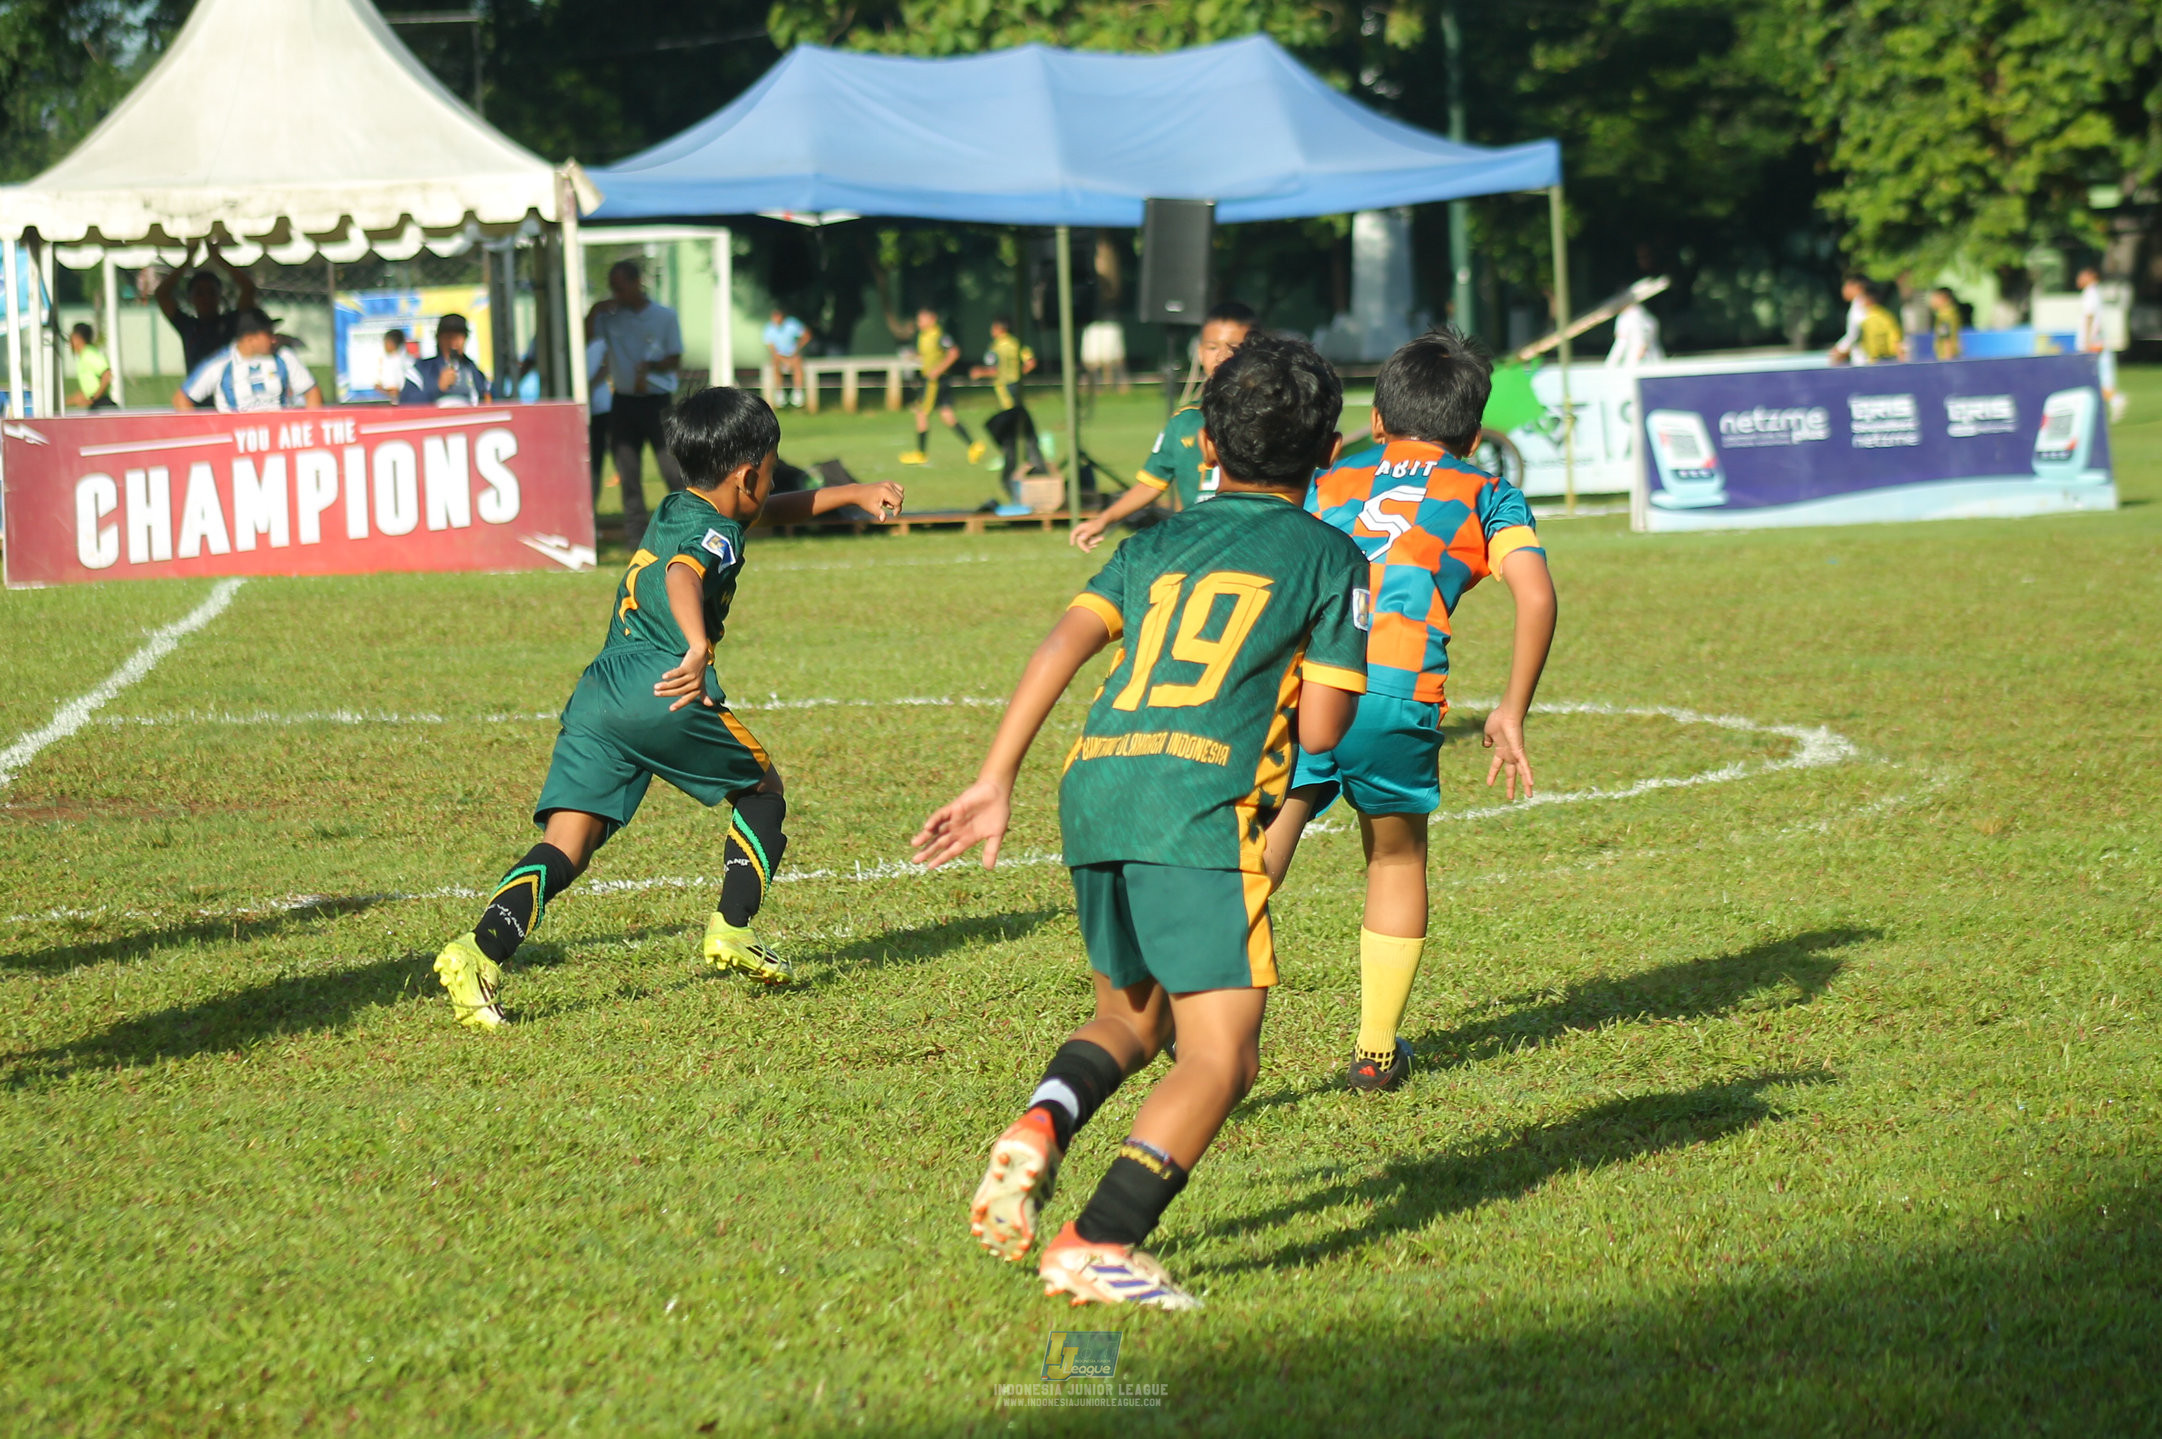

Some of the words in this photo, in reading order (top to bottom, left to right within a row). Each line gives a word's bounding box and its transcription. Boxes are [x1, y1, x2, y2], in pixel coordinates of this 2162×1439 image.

[234, 427, 270, 453] YOU
[279, 421, 313, 449] ARE
[321, 416, 356, 445] THE
[1719, 405, 1829, 434] netzme
[1374, 459, 1438, 478] ABIT
[75, 428, 520, 570] CHAMPIONS
[1112, 571, 1274, 712] 19
[1165, 731, 1231, 767] INDONESIA
